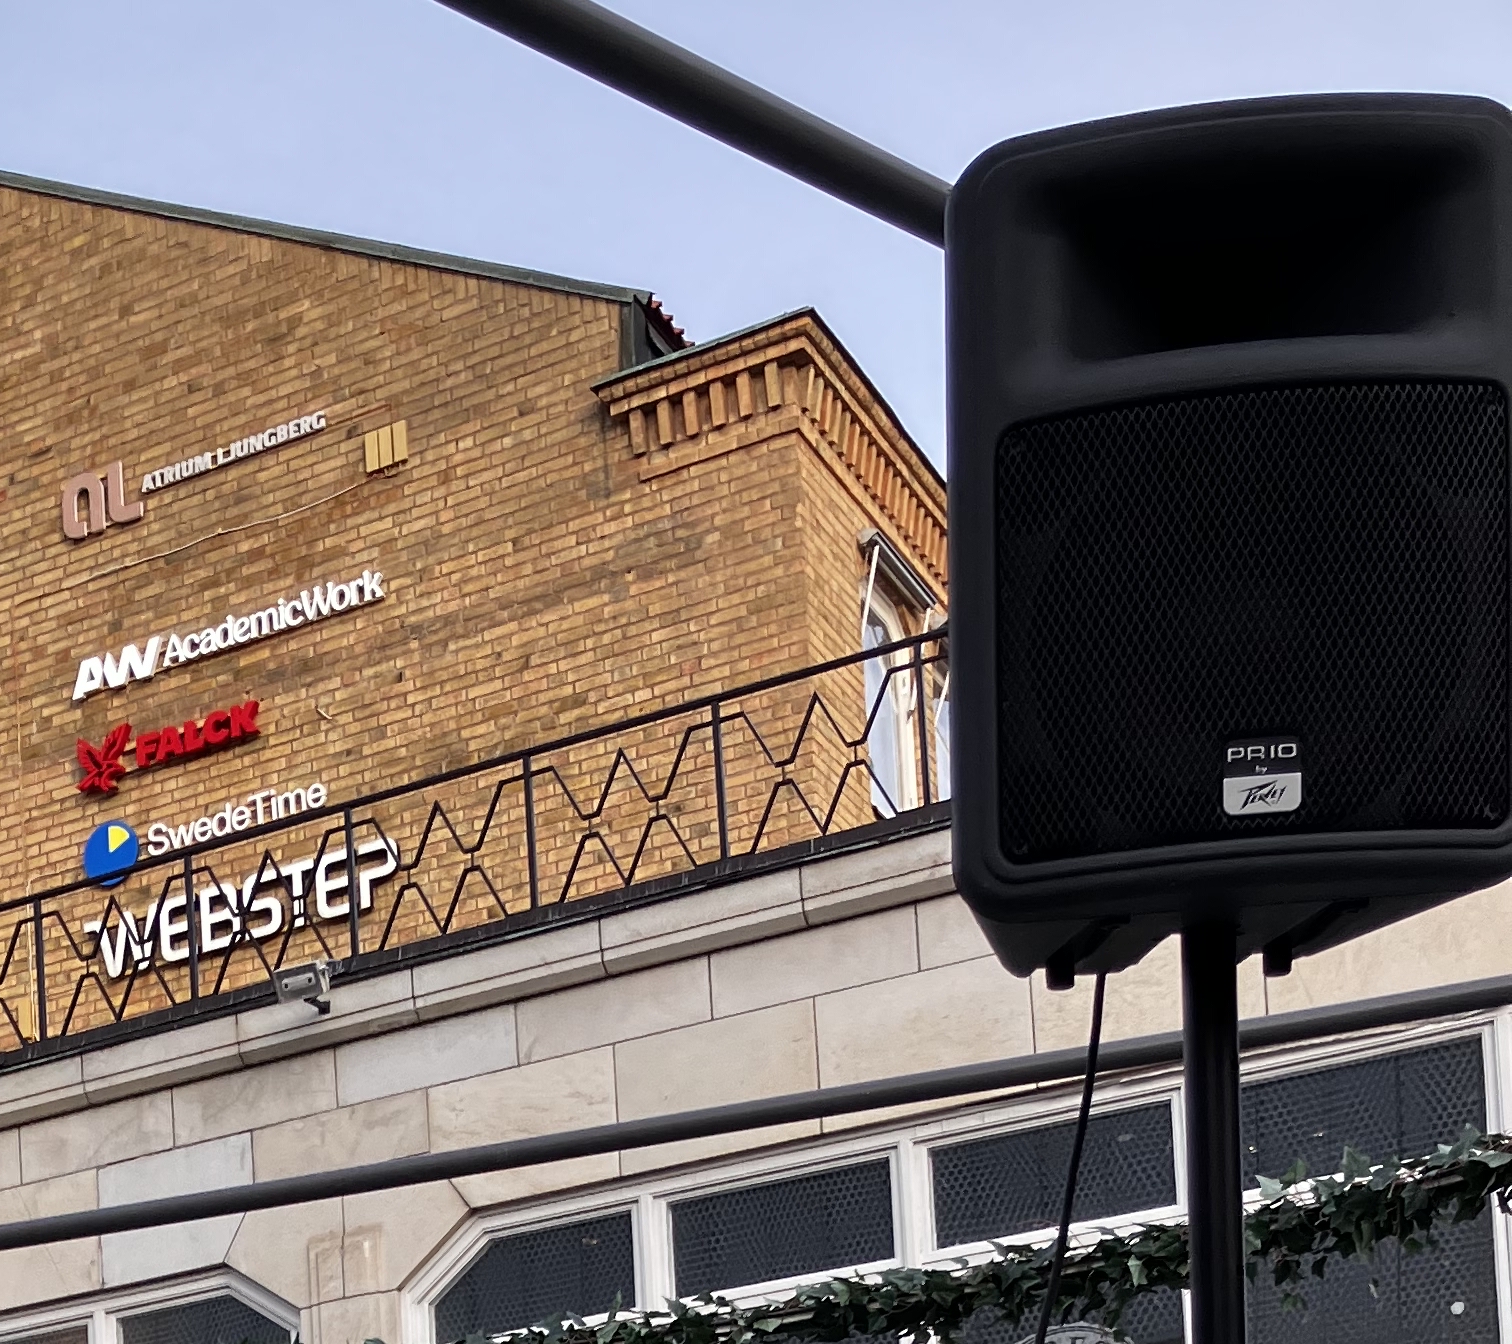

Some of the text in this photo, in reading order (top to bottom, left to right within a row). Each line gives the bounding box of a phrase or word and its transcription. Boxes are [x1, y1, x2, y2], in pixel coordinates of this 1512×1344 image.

[141, 451, 213, 493] ATRIUM
[216, 410, 327, 467] LJUNGBERG
[135, 700, 260, 769] FALCK
[1227, 743, 1298, 763] PRIO
[146, 782, 328, 856] SwedeTime
[83, 835, 399, 979] WEBSTEP
